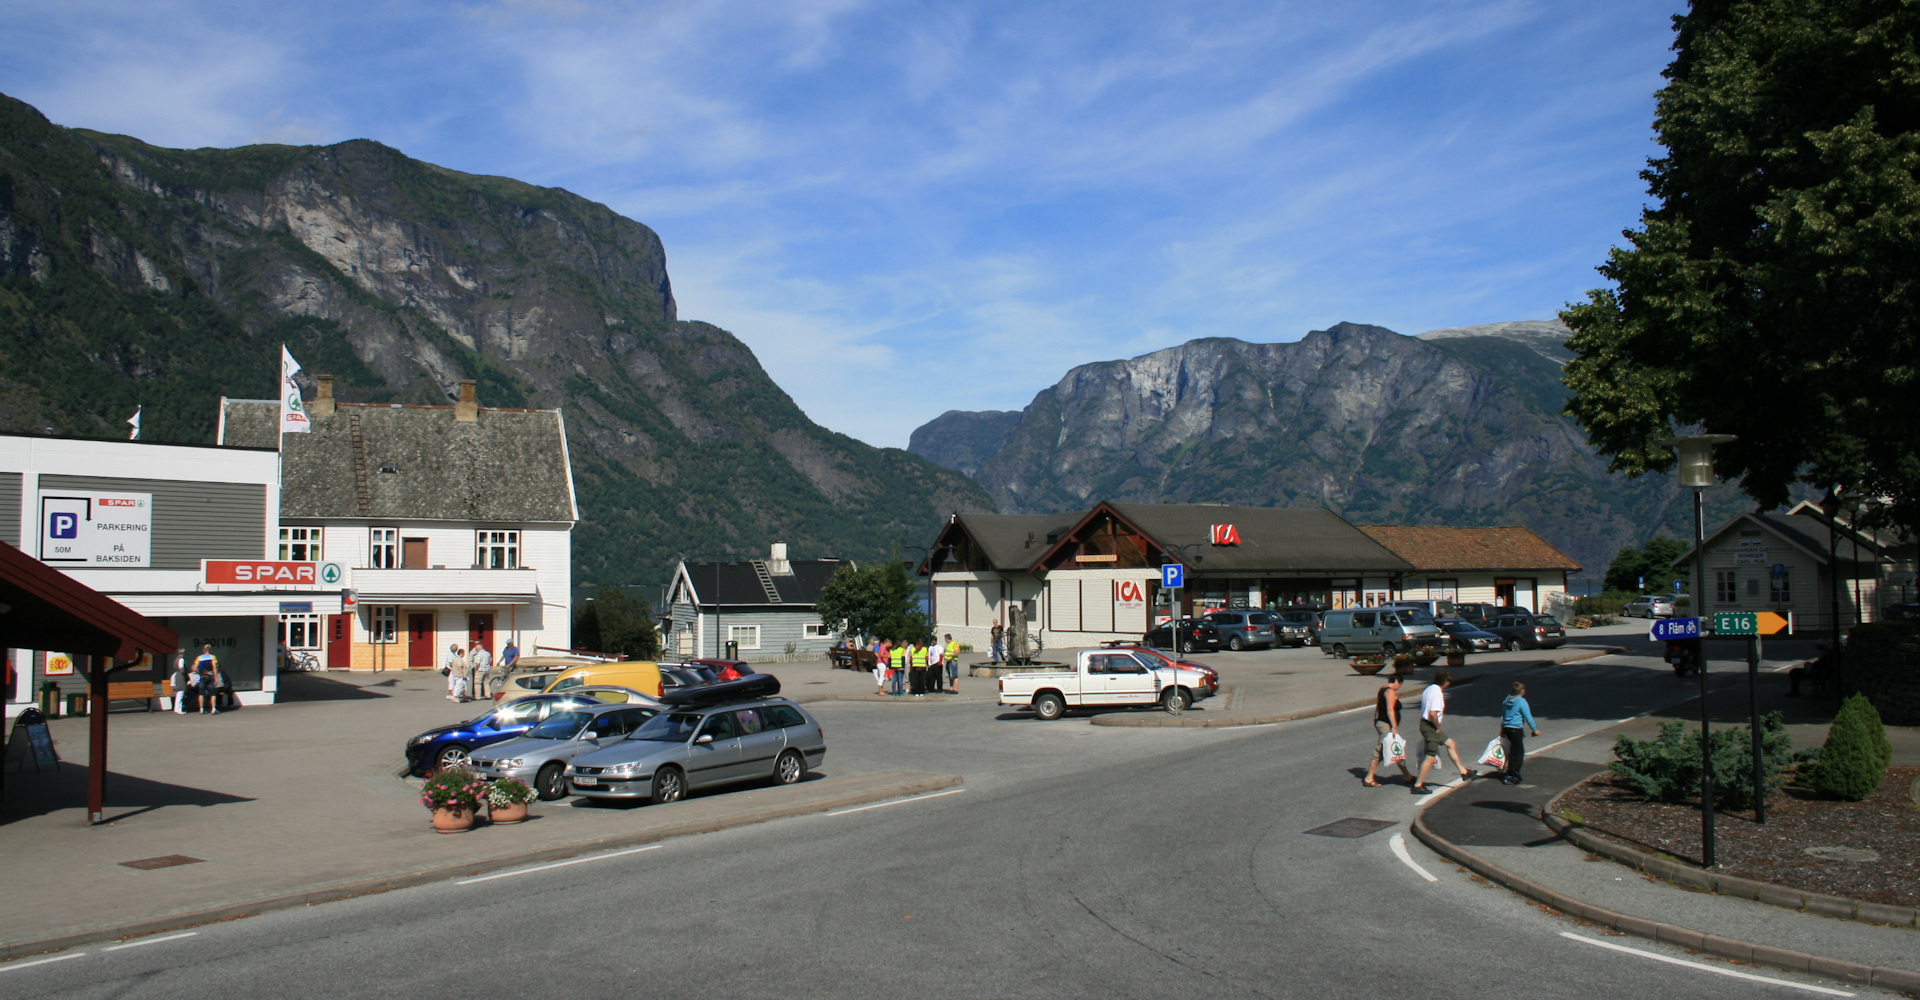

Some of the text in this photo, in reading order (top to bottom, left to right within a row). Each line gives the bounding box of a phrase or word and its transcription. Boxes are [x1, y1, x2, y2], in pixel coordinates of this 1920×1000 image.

[56, 516, 73, 536] P
[97, 523, 148, 531] PARKERING
[1211, 524, 1242, 545] ICA
[113, 543, 125, 552] PÅ
[96, 555, 141, 563] BAKSIDEN
[235, 565, 314, 580] SPAR
[1167, 567, 1178, 585] P
[1115, 581, 1144, 602] ICA
[1659, 622, 1685, 635] 8 Flåm
[1722, 618, 1750, 630] E 16
